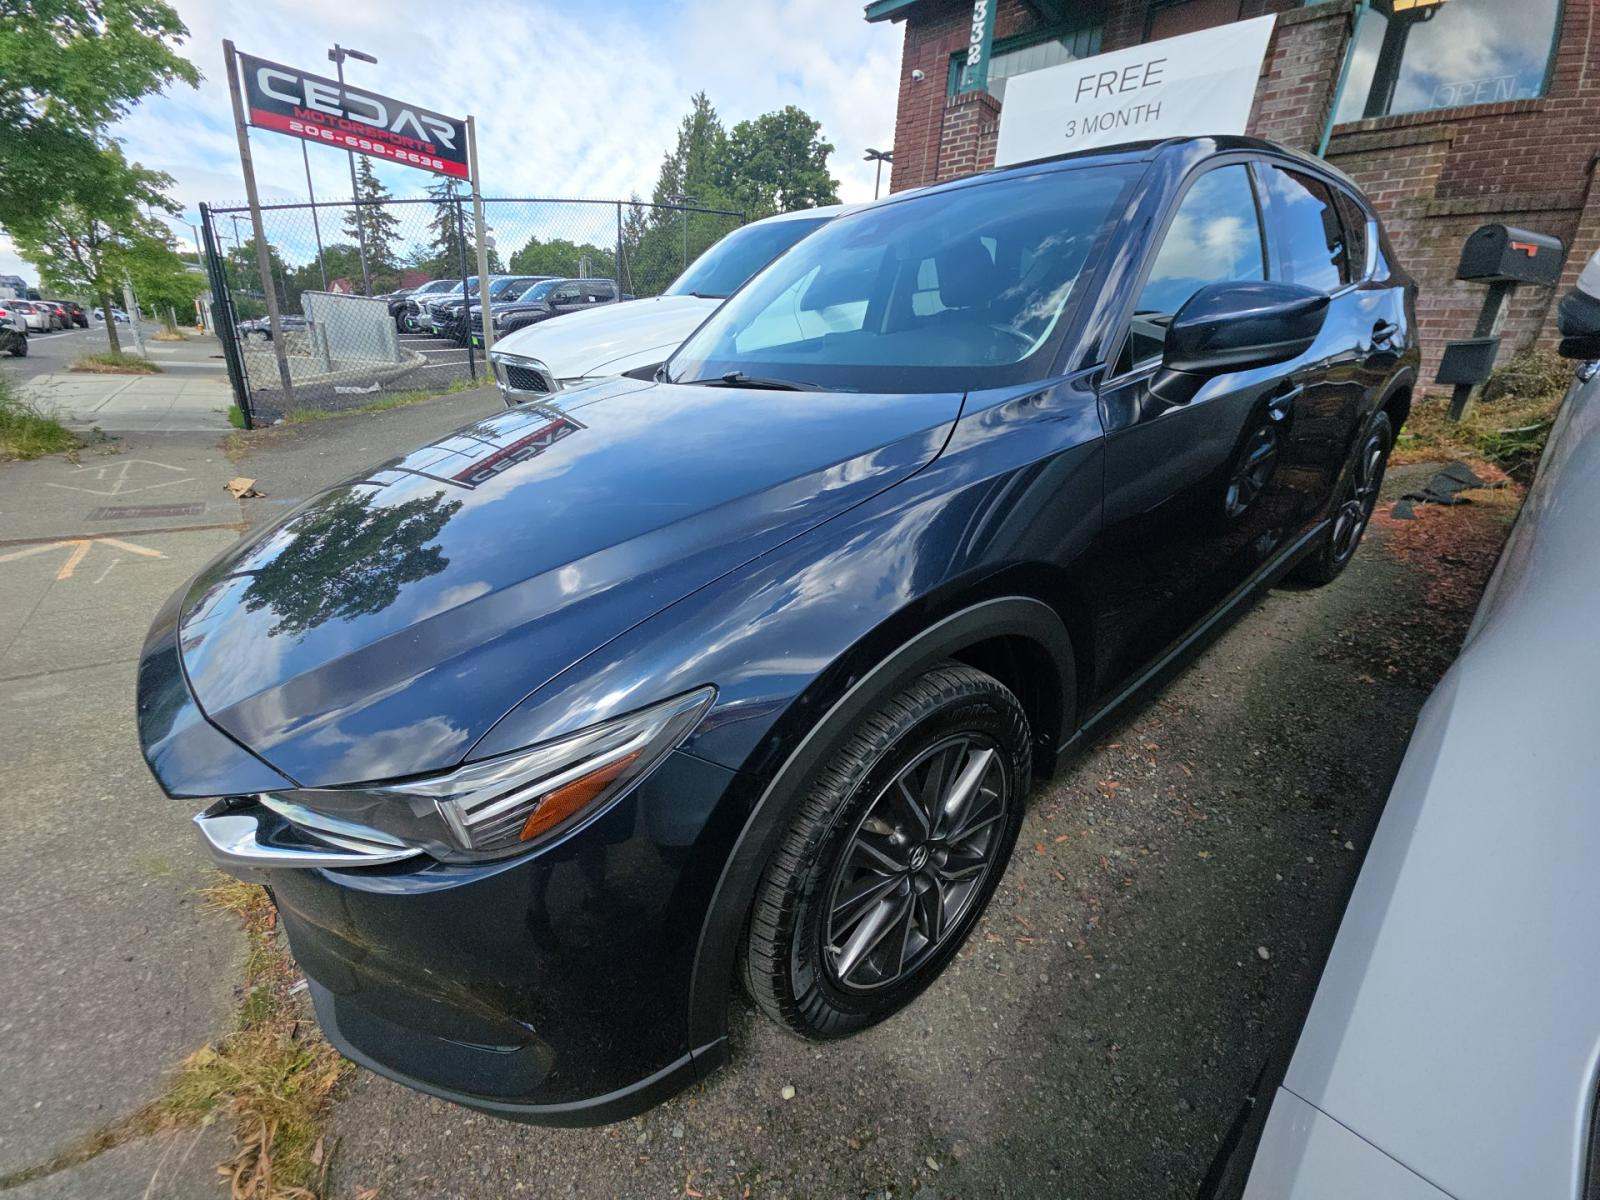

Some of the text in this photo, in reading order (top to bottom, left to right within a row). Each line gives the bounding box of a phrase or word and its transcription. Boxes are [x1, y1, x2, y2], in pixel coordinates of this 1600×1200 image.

[1075, 58, 1167, 103] FREE
[1436, 77, 1515, 107] OPEN
[256, 67, 456, 149] CEDAR
[294, 106, 436, 154] MOTORSPORTS
[1065, 102, 1162, 138] 3 MONTH
